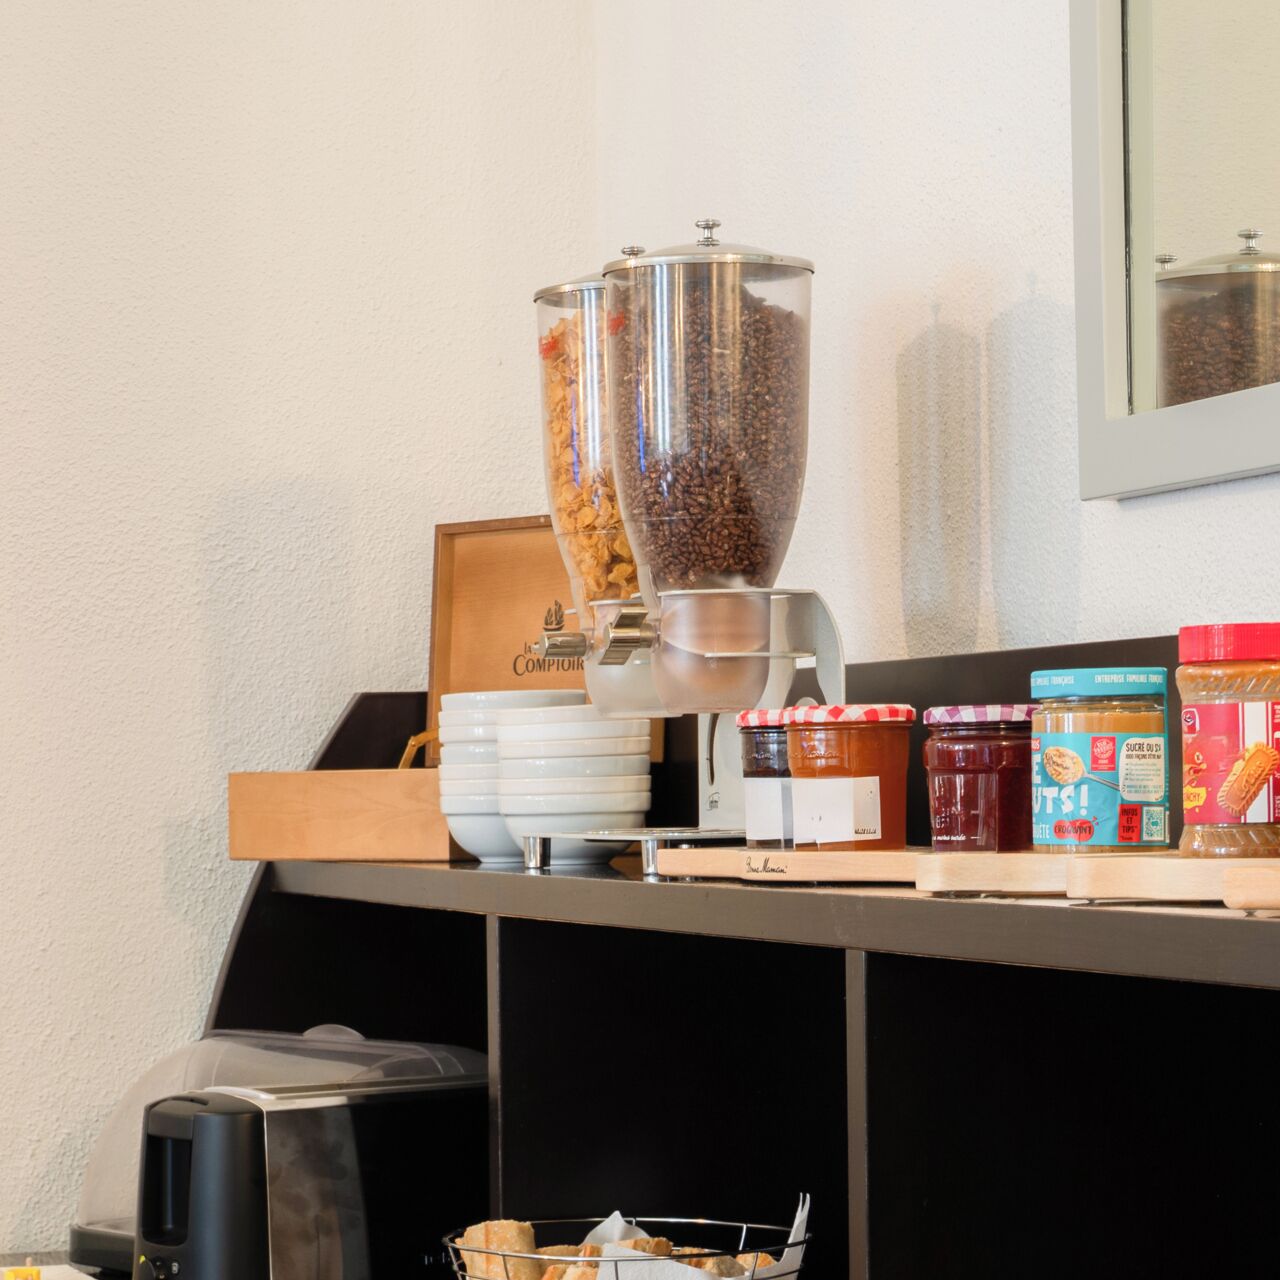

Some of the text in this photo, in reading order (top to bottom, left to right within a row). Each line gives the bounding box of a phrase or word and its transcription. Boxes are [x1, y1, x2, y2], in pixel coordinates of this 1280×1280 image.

[513, 654, 584, 676] COMPTOIR
[1126, 742, 1145, 752] SUCRÉ
[1032, 784, 1089, 816] UTS!
